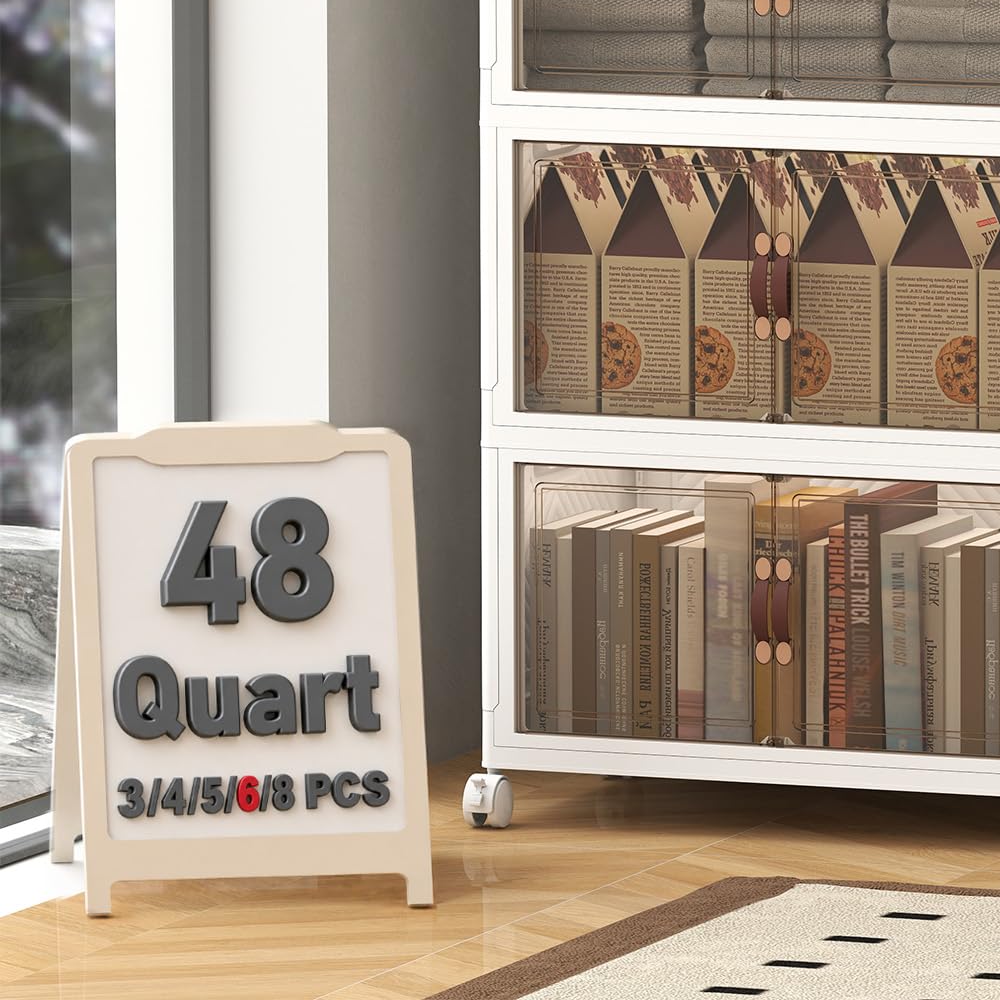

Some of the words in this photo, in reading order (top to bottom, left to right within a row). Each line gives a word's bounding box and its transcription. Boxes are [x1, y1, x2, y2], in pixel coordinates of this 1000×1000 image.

[850, 514, 868, 537] THE
[159, 496, 335, 625] 48
[686, 557, 696, 582] Carol
[850, 539, 869, 585] BULLET
[891, 552, 905, 568] TIM
[686, 585, 696, 618] Shields
[850, 588, 870, 625] TRICK
[892, 572, 906, 608] WINTON
[892, 610, 906, 633] DIRT
[828, 613, 845, 712] PALAHNIUK
[851, 627, 871, 672] LOUISE
[893, 635, 907, 667] MUSIC
[112, 653, 382, 741] Quart
[851, 676, 871, 718] WELSH
[117, 773, 297, 820] 3/4/5/6/8
[305, 770, 391, 810] PCS
